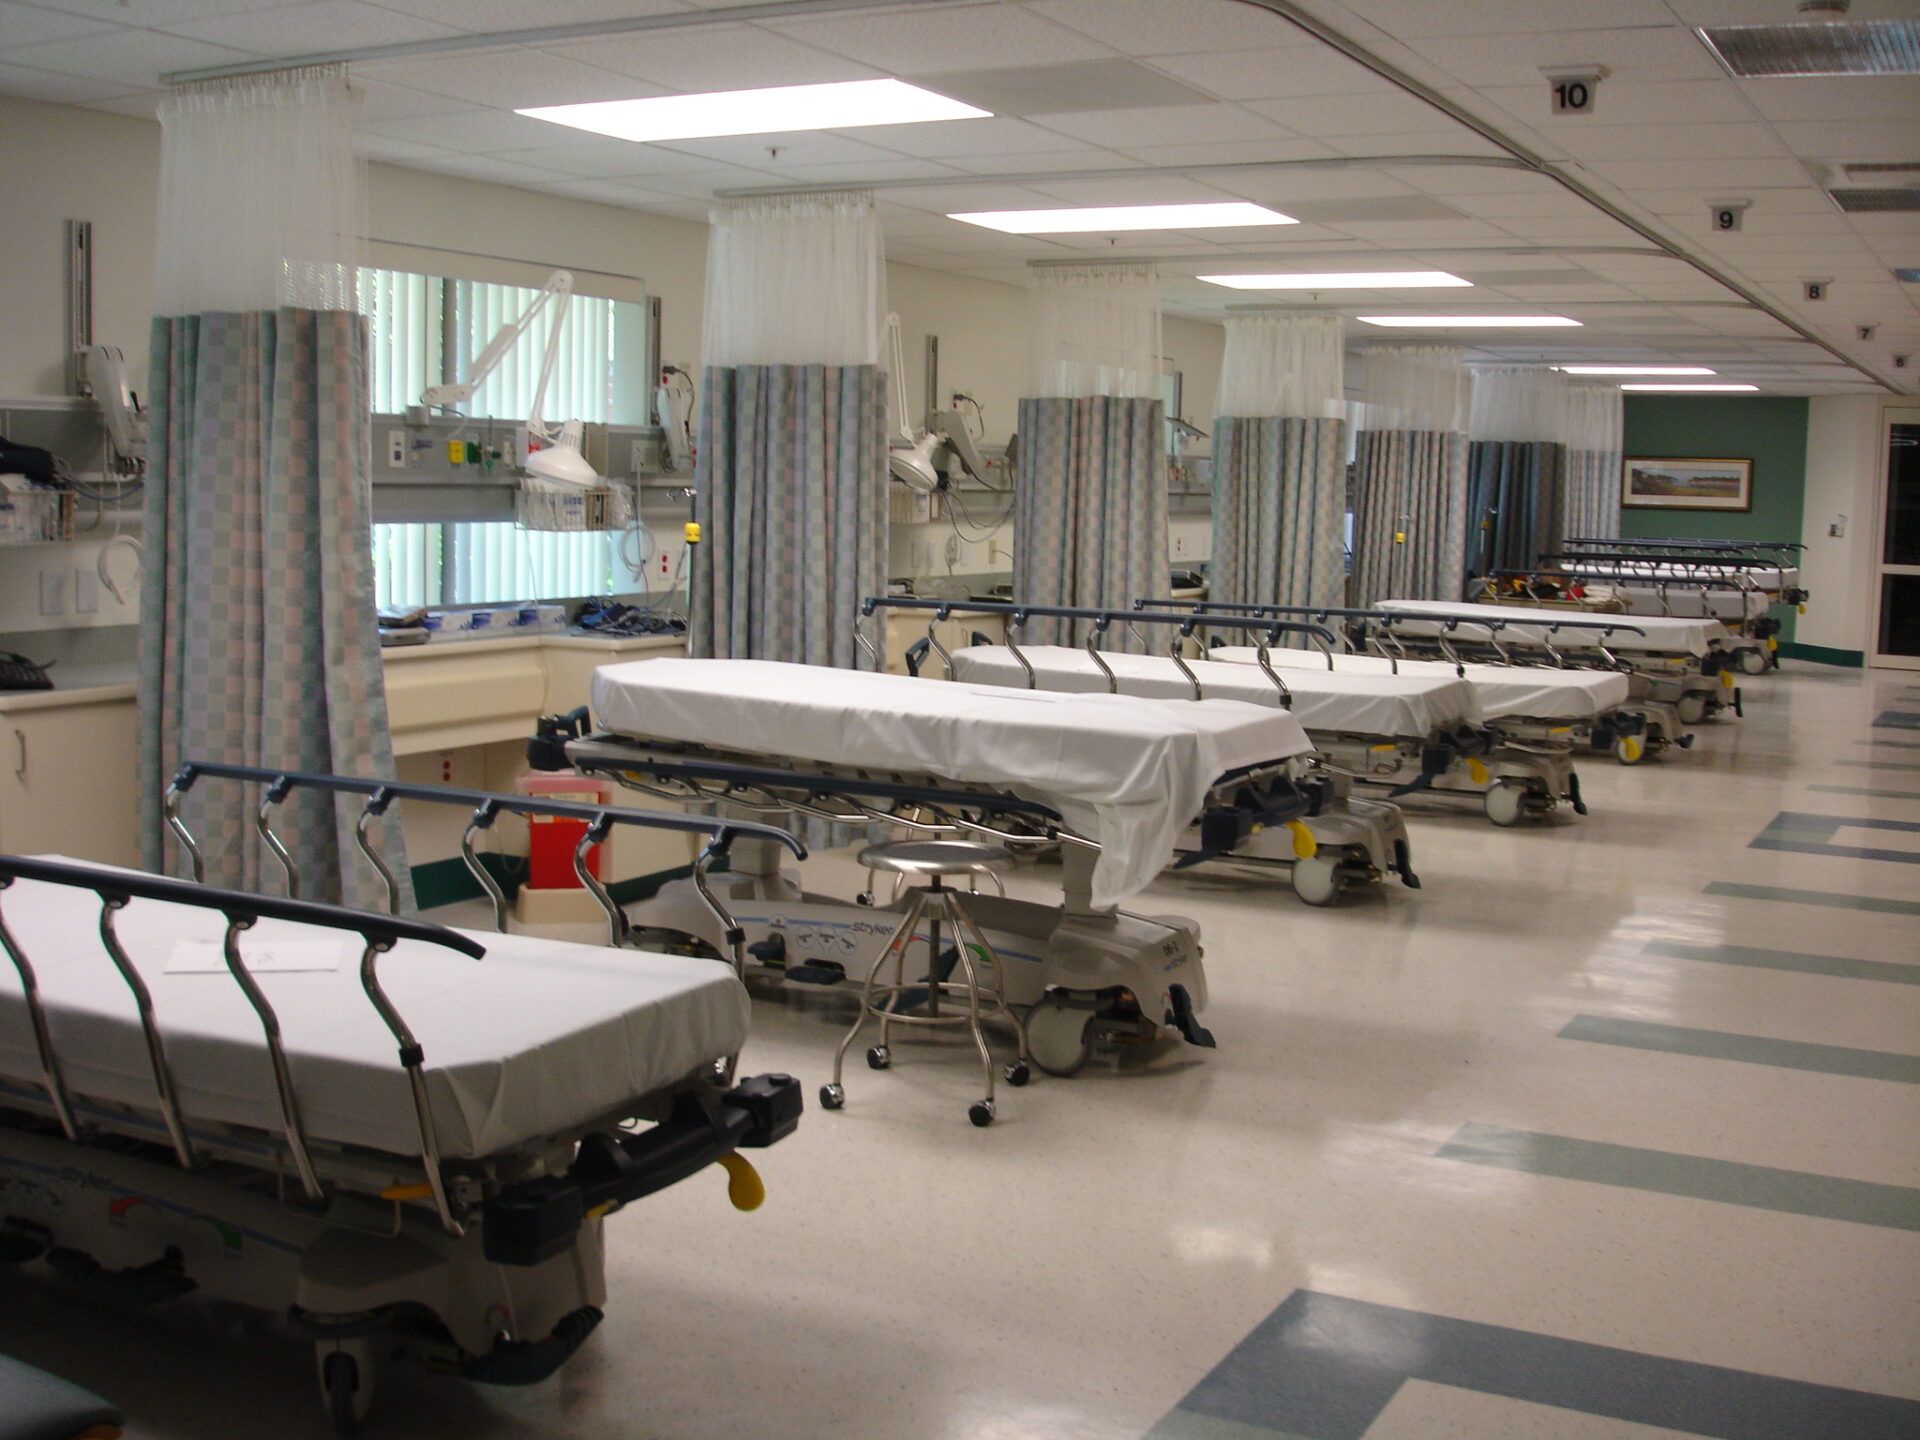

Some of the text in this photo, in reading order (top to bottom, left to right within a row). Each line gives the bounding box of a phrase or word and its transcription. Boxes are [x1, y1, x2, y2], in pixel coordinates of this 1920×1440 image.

[1554, 83, 1588, 109] 10
[1719, 211, 1734, 229] 9
[1808, 285, 1820, 299] 8
[1861, 328, 1870, 340] 7
